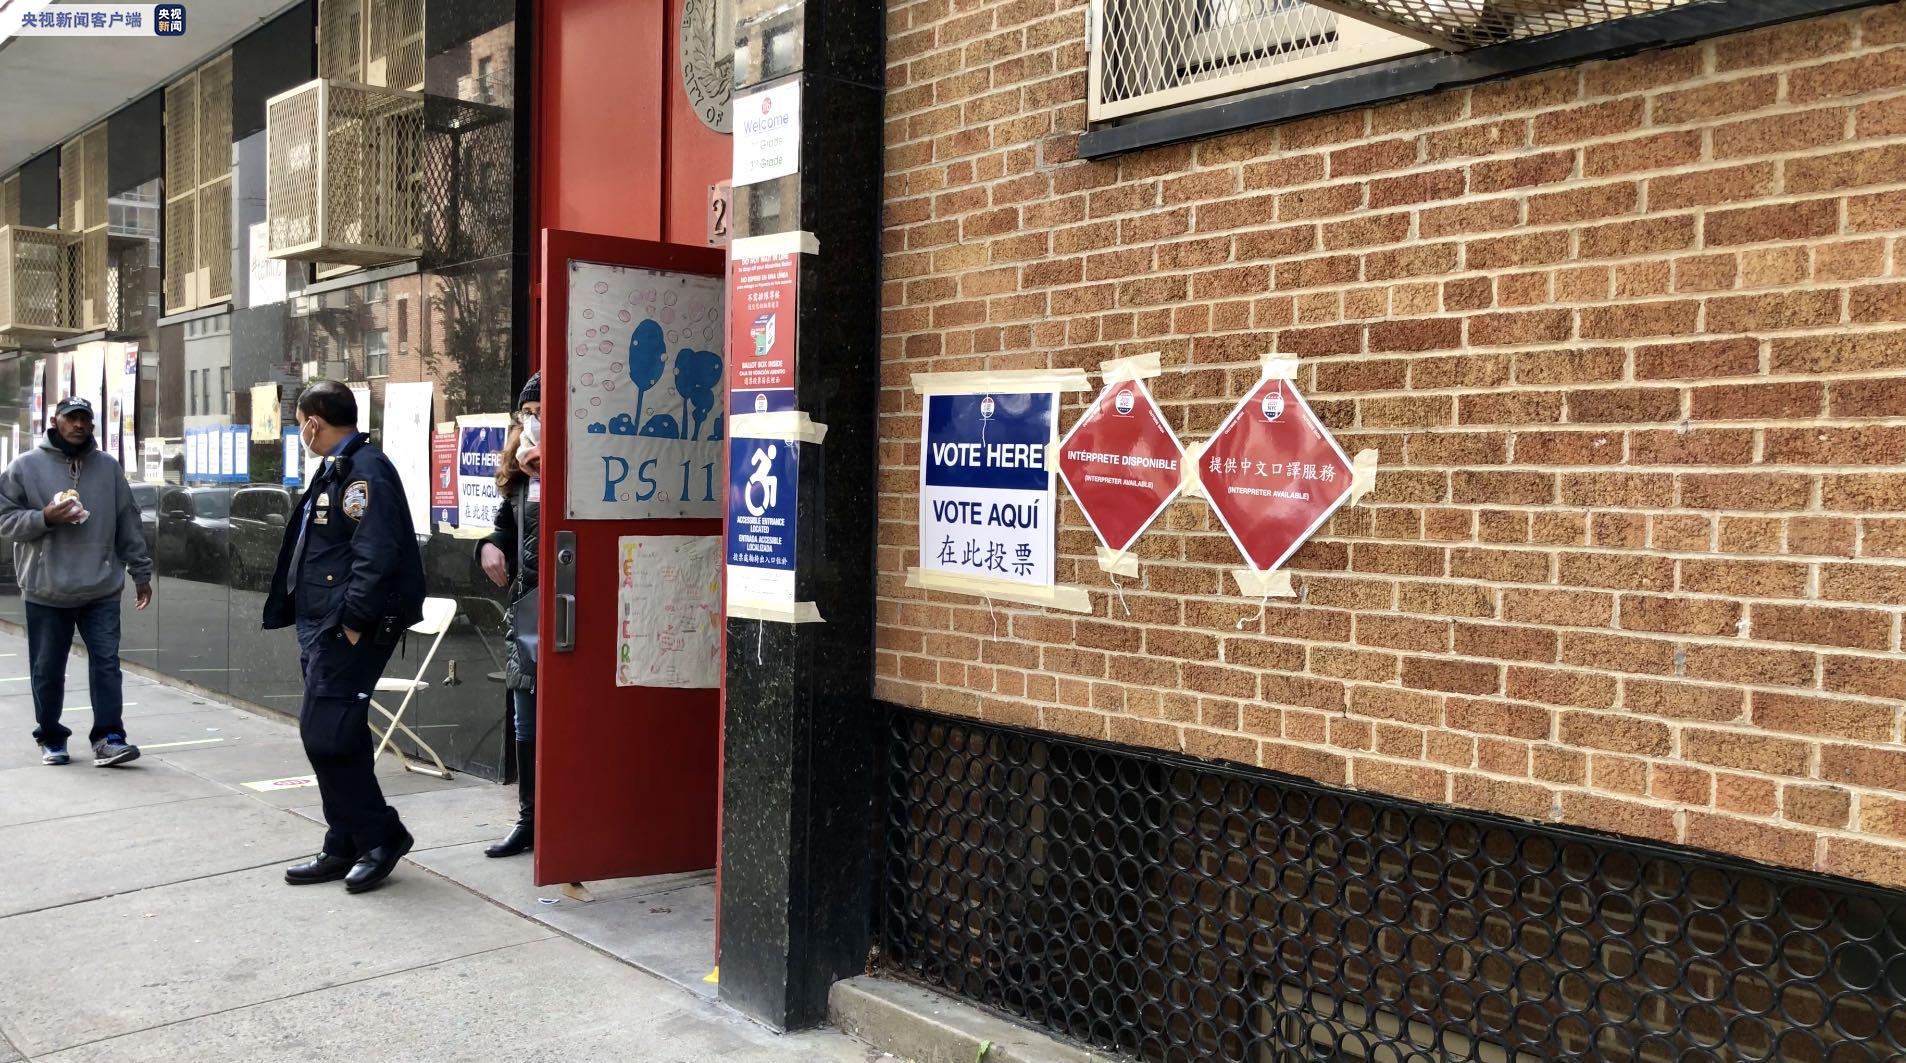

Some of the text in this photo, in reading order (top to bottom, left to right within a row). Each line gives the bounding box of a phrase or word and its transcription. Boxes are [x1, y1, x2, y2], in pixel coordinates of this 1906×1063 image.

[744, 114, 788, 134] Welcome
[462, 452, 481, 466] VOTE
[482, 452, 502, 467] HERE
[932, 442, 1043, 468] VOTE HERE
[1067, 449, 1177, 470] INTÉRPRETE DISPONIBLE
[1208, 456, 1337, 482] 提供中文口譯服務
[462, 483, 480, 496] VOTE
[1084, 474, 1154, 489] (INTERPRETER AVAILABLE)
[1227, 486, 1310, 502] (INTERPRETER AVAILABLE)
[737, 516, 785, 526] ACCESSIBLE ENTRANCE
[933, 498, 1039, 529] VOTE AQUÍ
[750, 525, 770, 533] LOCATED
[937, 534, 1035, 577] 在此投票
[620, 544, 636, 684] TEAHERS
